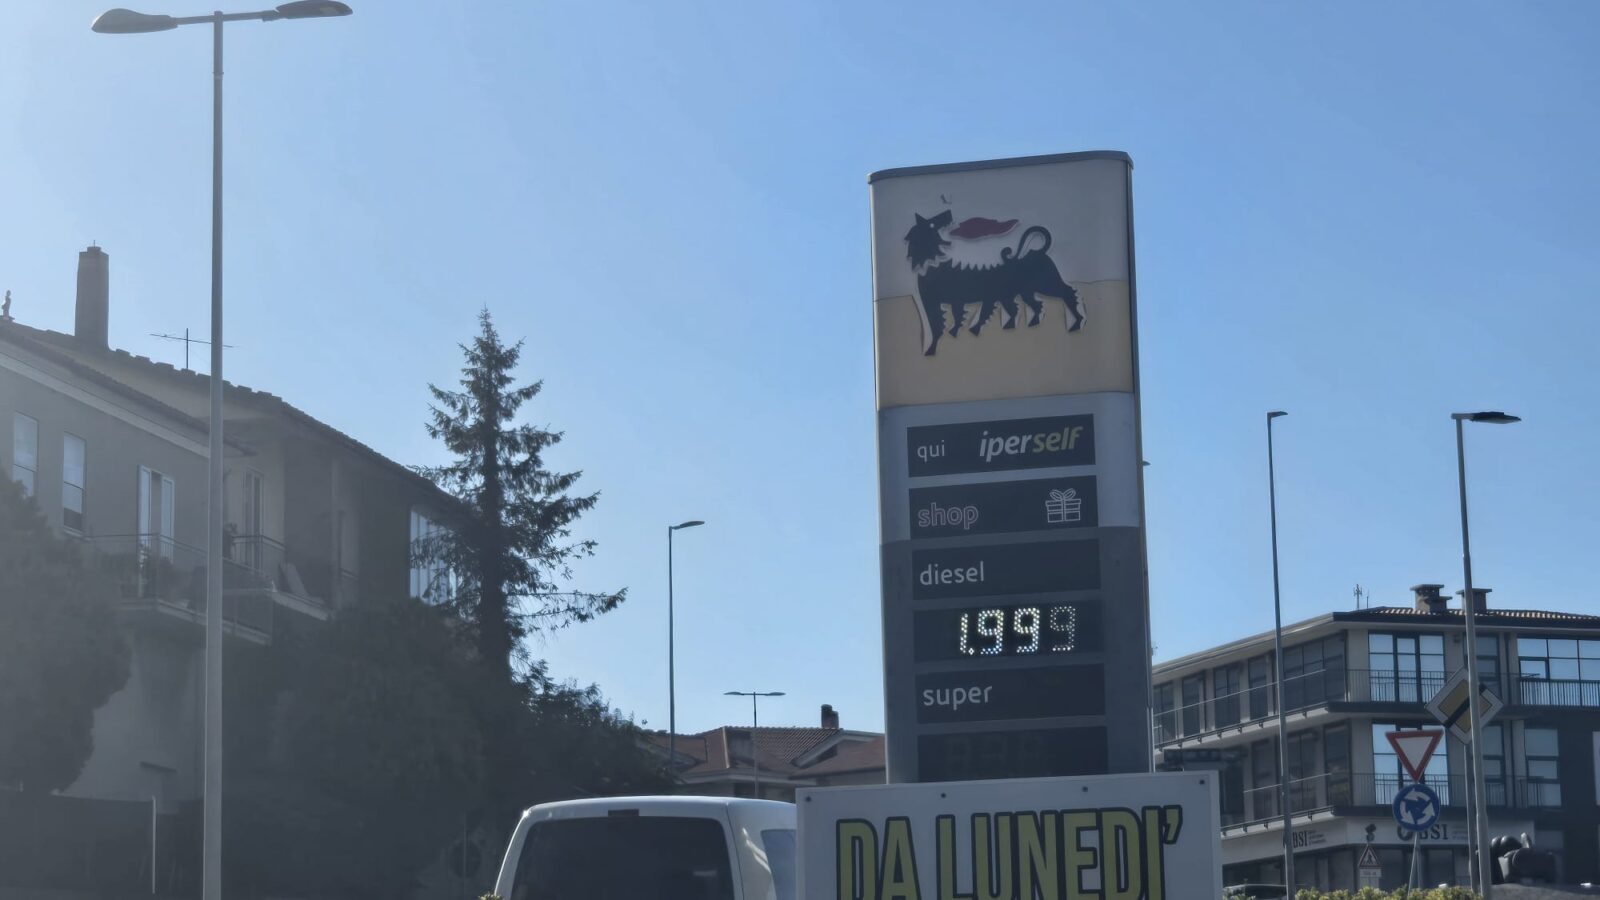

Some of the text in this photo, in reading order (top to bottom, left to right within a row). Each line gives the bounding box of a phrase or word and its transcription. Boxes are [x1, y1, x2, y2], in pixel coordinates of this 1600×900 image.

[917, 426, 1084, 462] qui iperself
[918, 502, 979, 530] shop
[919, 560, 985, 586] diesel
[922, 685, 993, 711] super
[836, 815, 922, 900] DA
